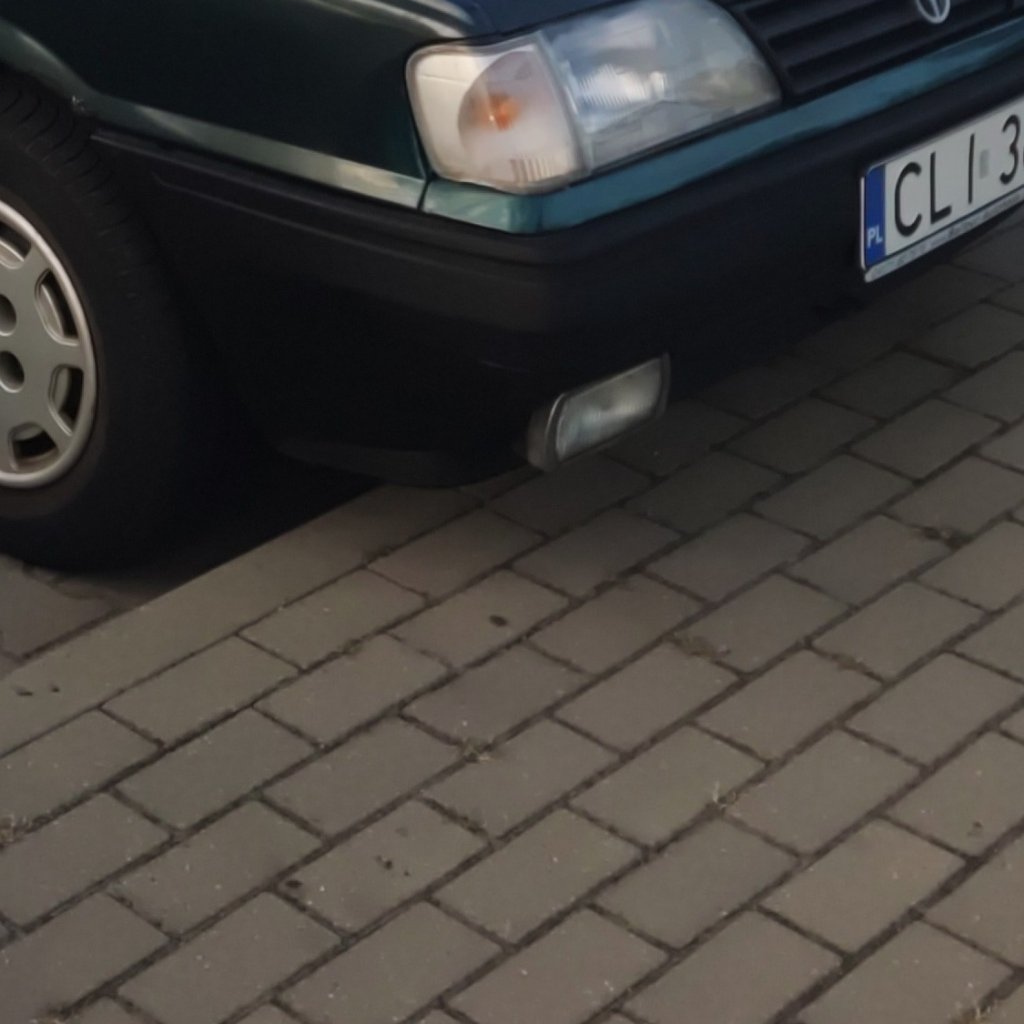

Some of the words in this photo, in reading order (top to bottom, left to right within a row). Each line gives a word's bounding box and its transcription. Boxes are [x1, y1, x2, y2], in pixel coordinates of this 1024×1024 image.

[894, 133, 975, 237] CLI
[999, 114, 1024, 185] 3
[867, 228, 883, 248] PL
